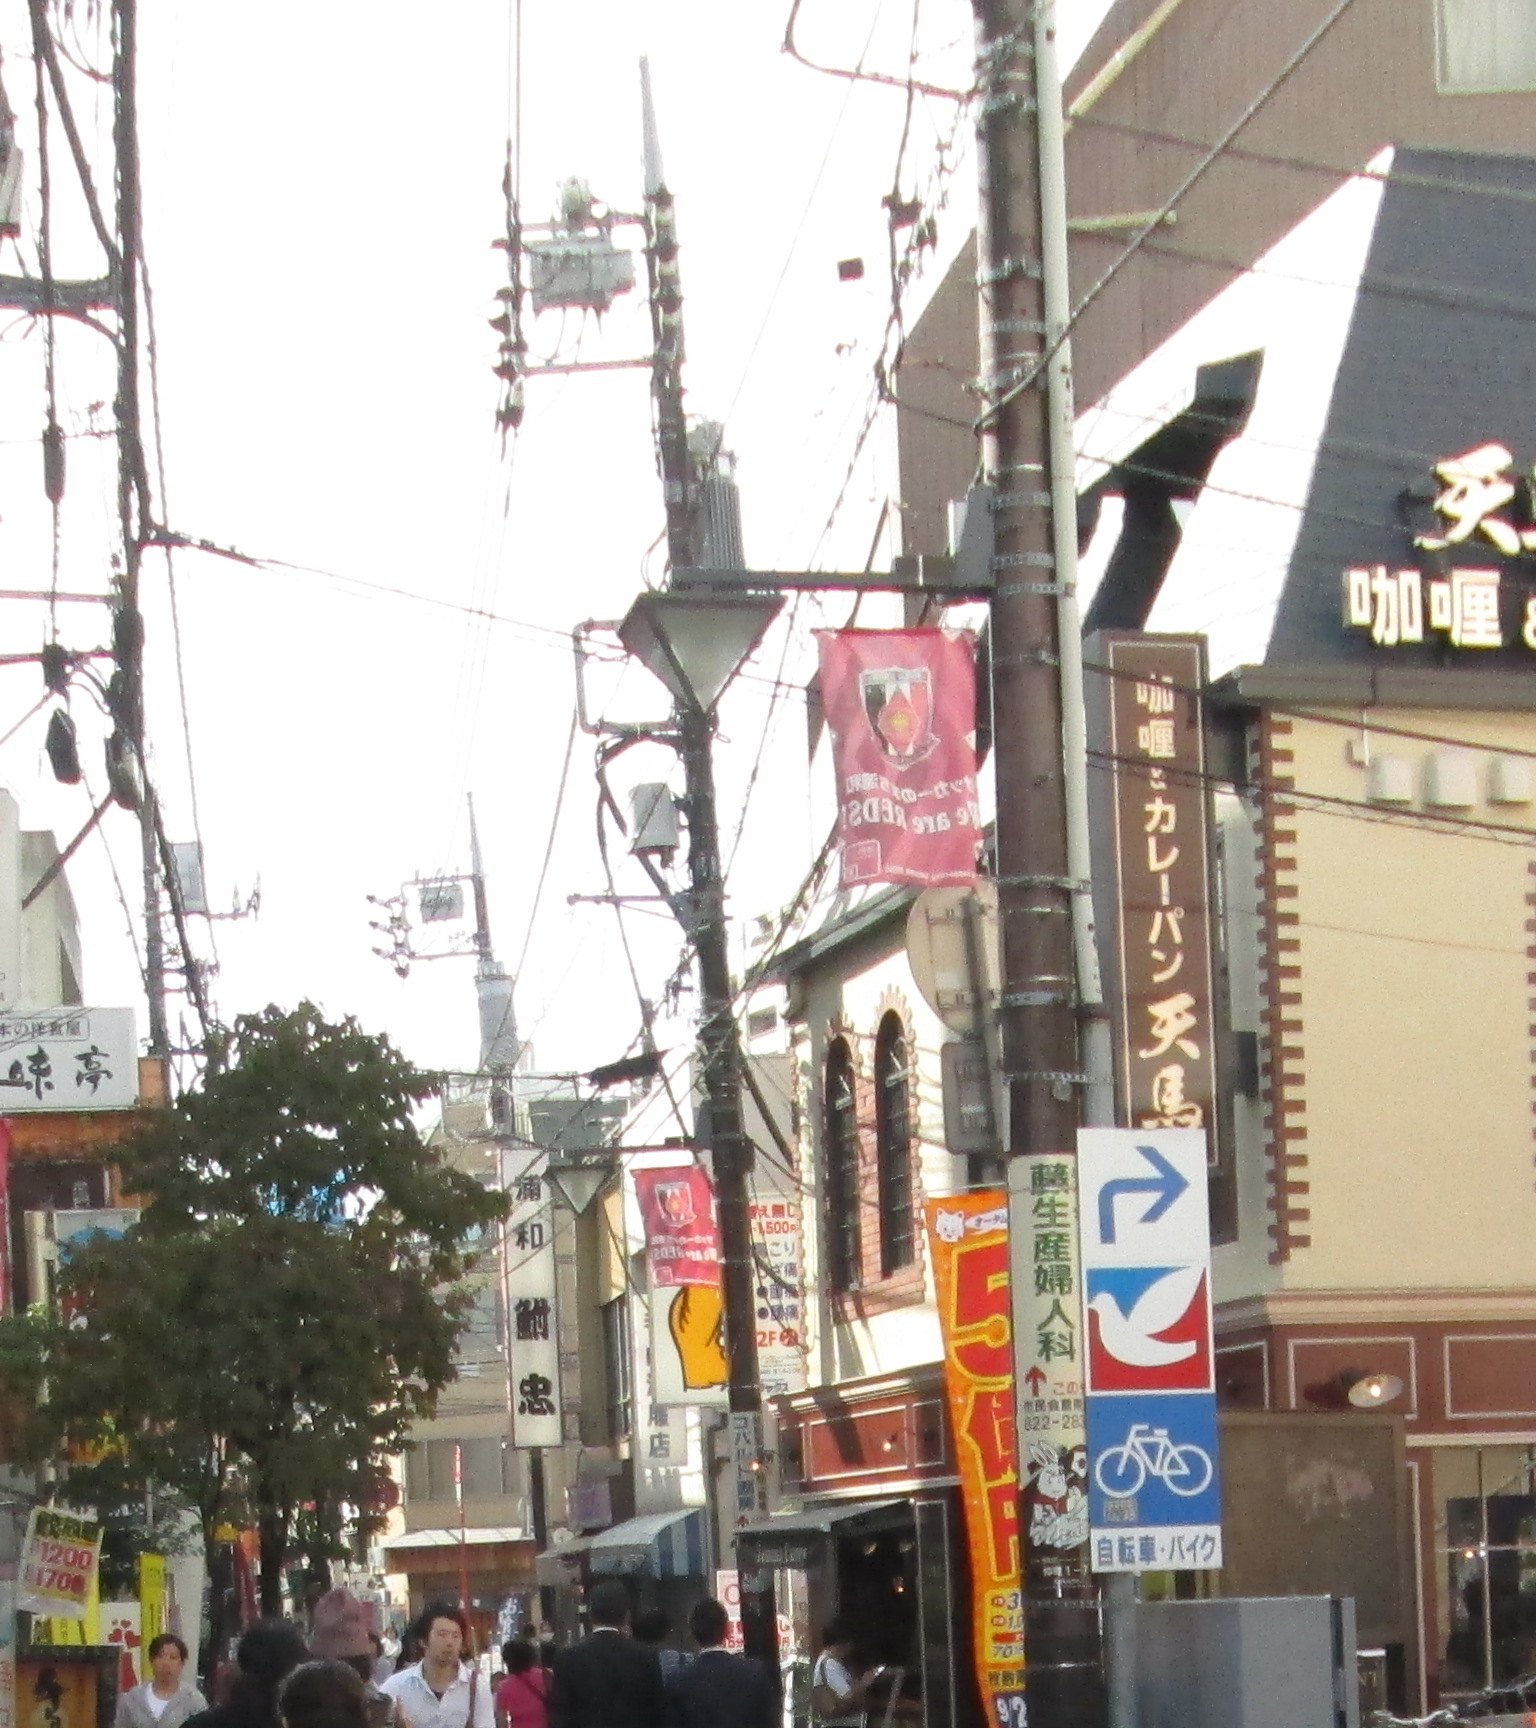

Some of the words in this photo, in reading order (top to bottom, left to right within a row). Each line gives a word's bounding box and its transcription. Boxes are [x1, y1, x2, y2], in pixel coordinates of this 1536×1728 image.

[1096, 1533, 1216, 1567] 自転車・バイク
